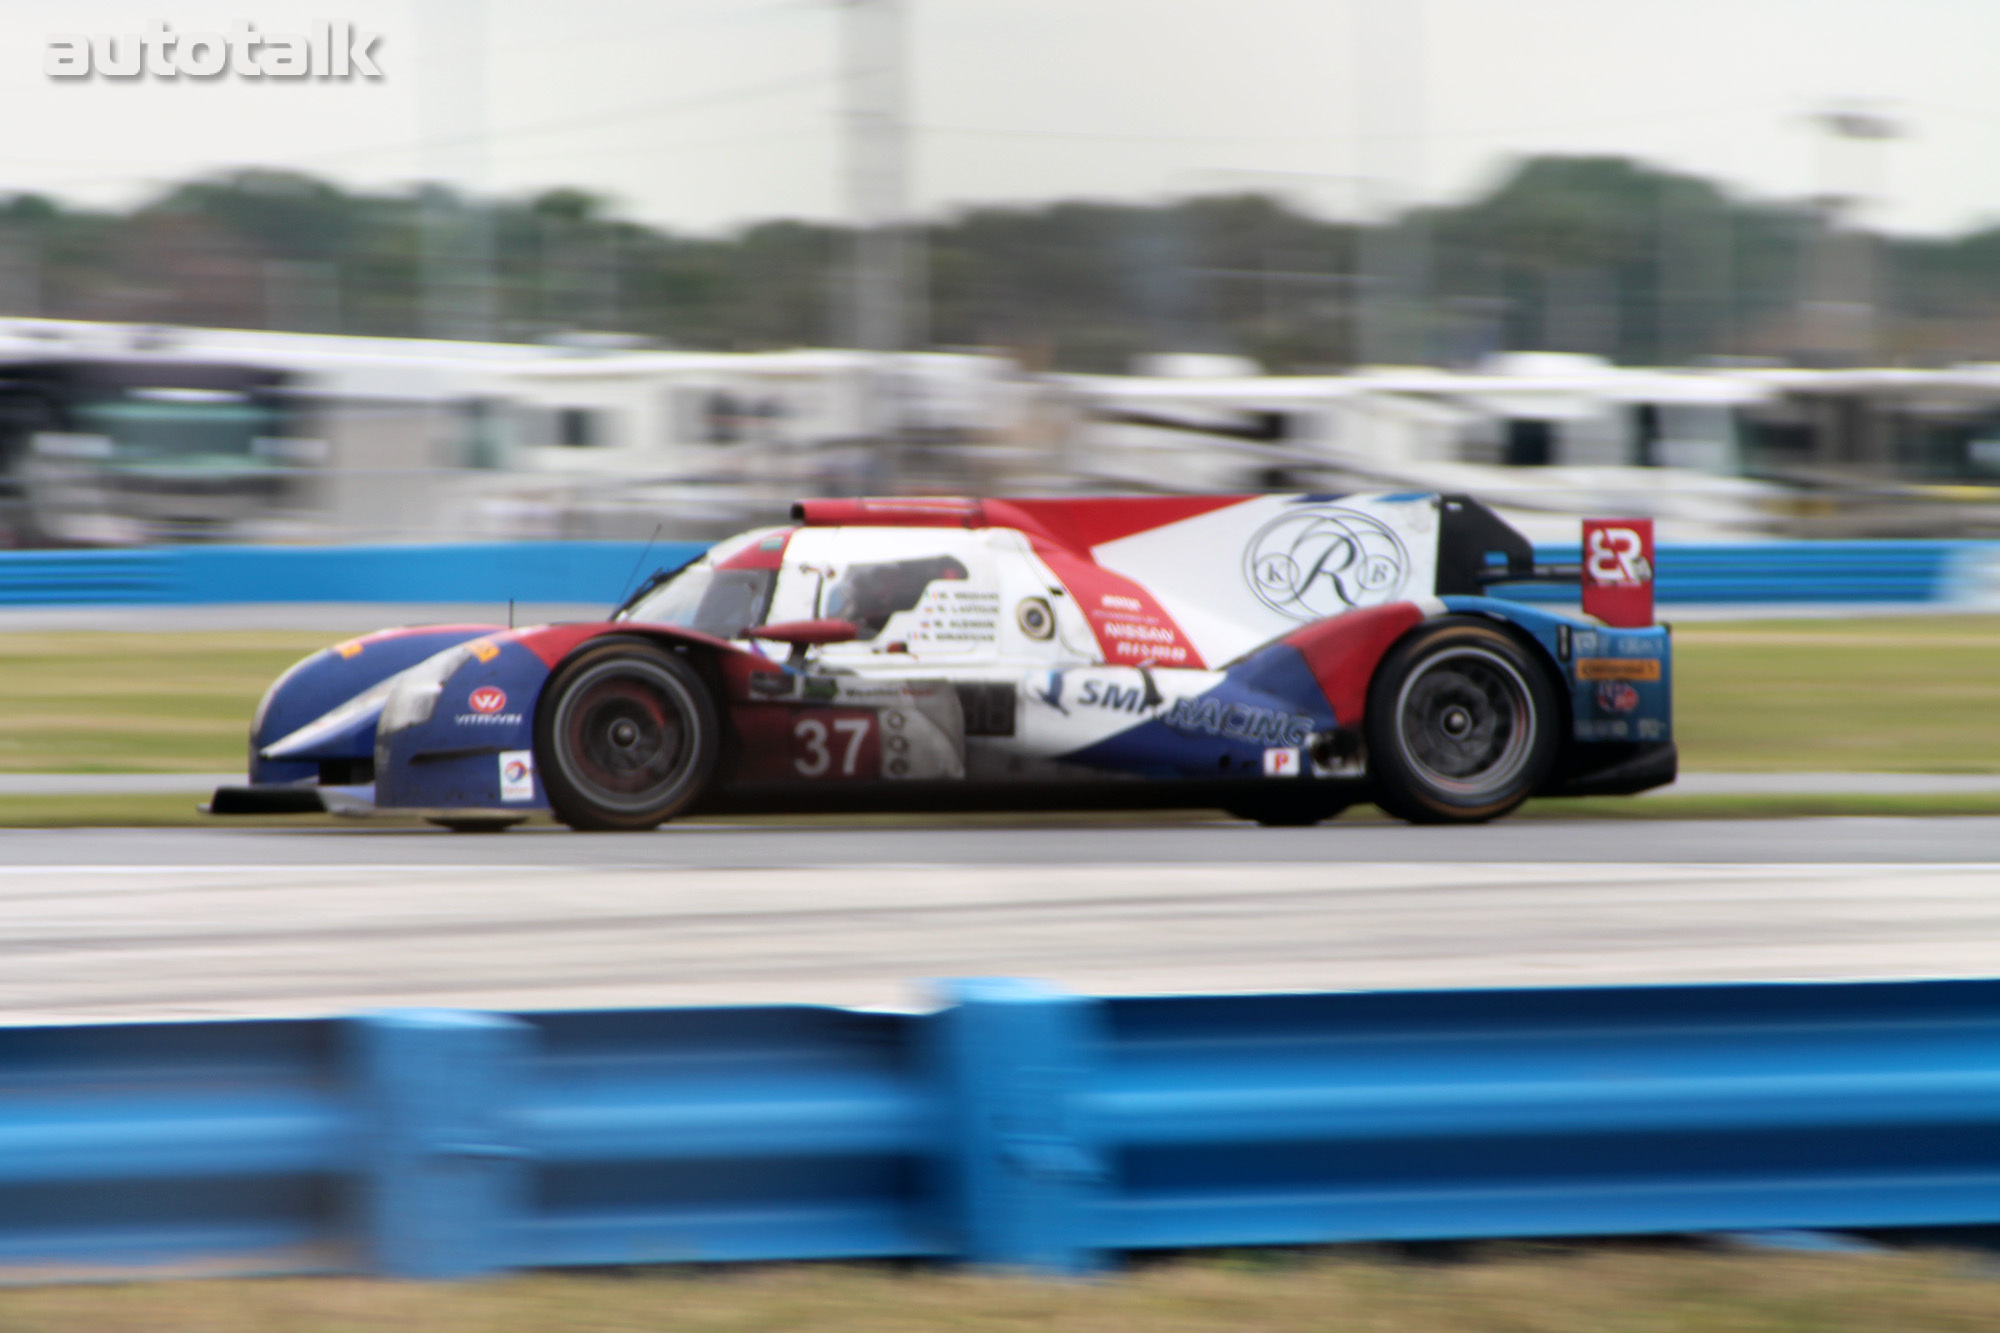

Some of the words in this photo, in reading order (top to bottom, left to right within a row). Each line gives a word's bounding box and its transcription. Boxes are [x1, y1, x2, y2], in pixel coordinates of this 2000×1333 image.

[1104, 622, 1175, 645] NISSAN
[794, 718, 870, 776] 37
[1163, 695, 1315, 747] RACING
